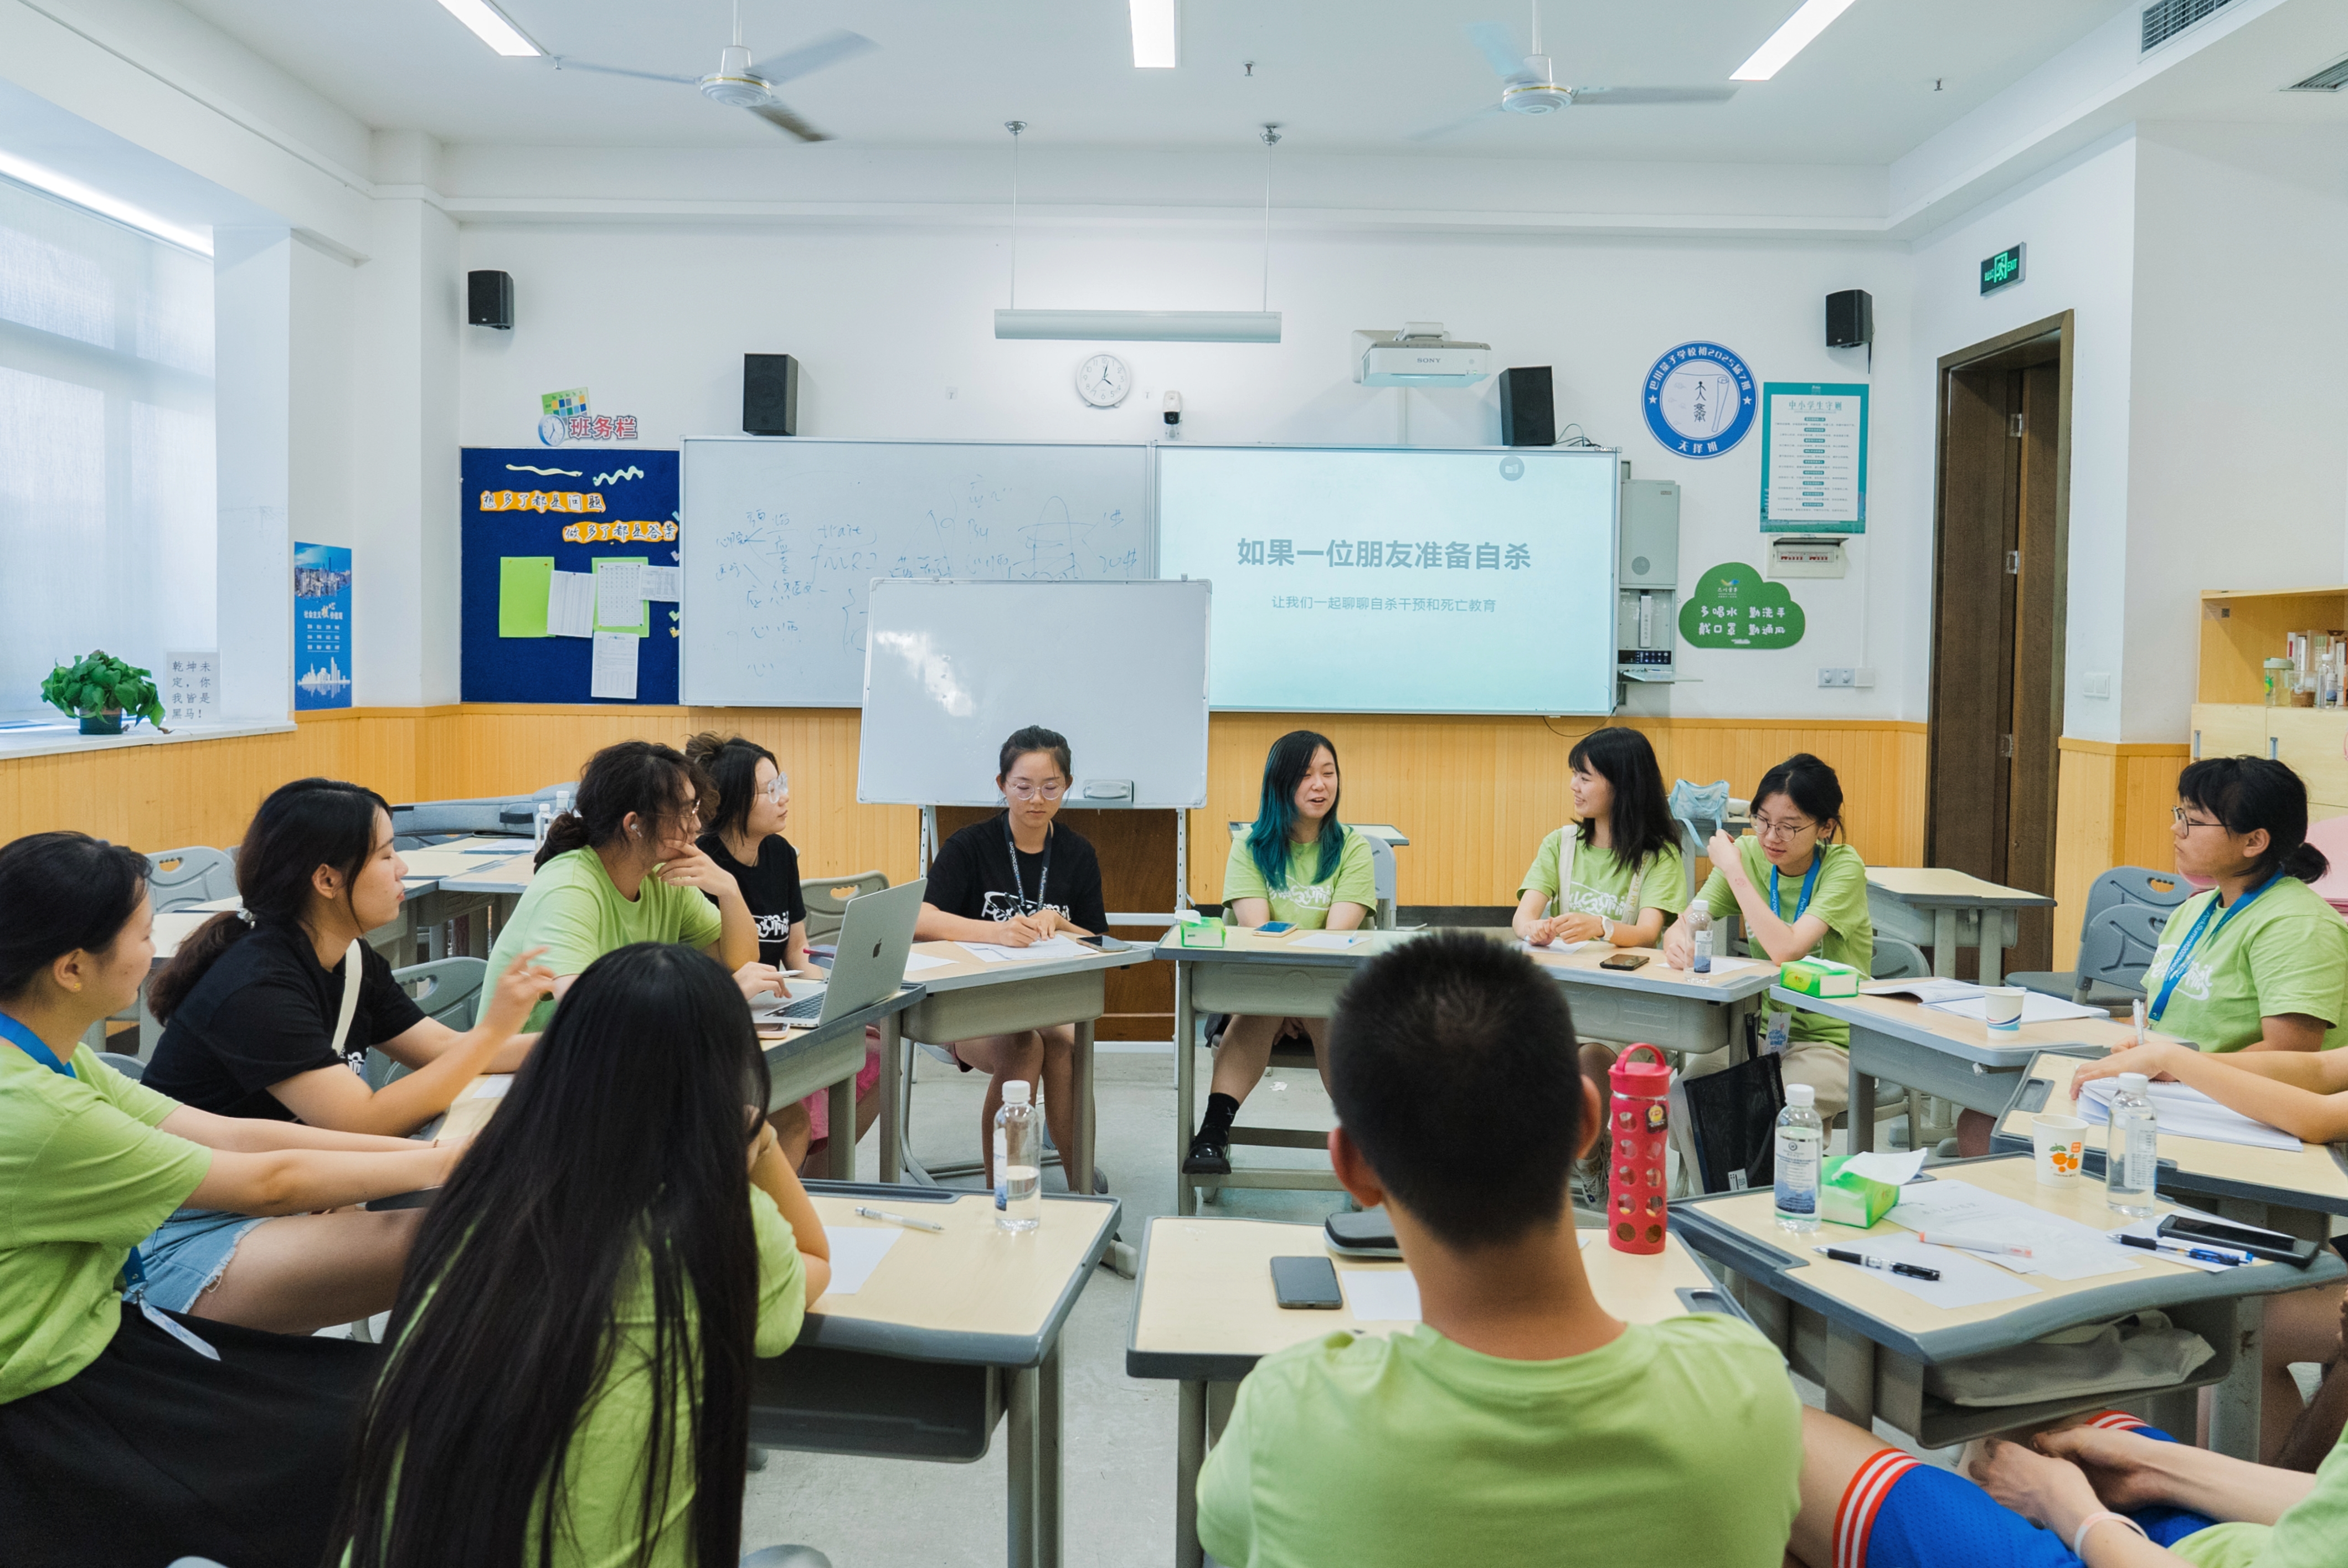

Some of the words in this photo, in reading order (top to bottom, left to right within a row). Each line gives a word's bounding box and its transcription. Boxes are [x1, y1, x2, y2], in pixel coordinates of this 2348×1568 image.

[1789, 400, 1842, 411] 中小学生守则
[569, 416, 638, 440] 班务栏
[483, 493, 605, 512] 想多了都是问题
[565, 522, 676, 540] 做多了都是答案
[1238, 538, 1531, 570] 如果一位朋友准备自杀
[1272, 595, 1496, 613] 让我们一起聊聊自杀干预和死亡教育
[1701, 606, 1737, 617] 多喝水
[1749, 606, 1785, 618] 勤洗手
[1699, 623, 1736, 635] 戴口罩
[1748, 624, 1785, 635] 勤通风
[172, 661, 211, 672] 乾坤未
[172, 693, 211, 704] 我皆是
[172, 708, 202, 720] 黑马！
